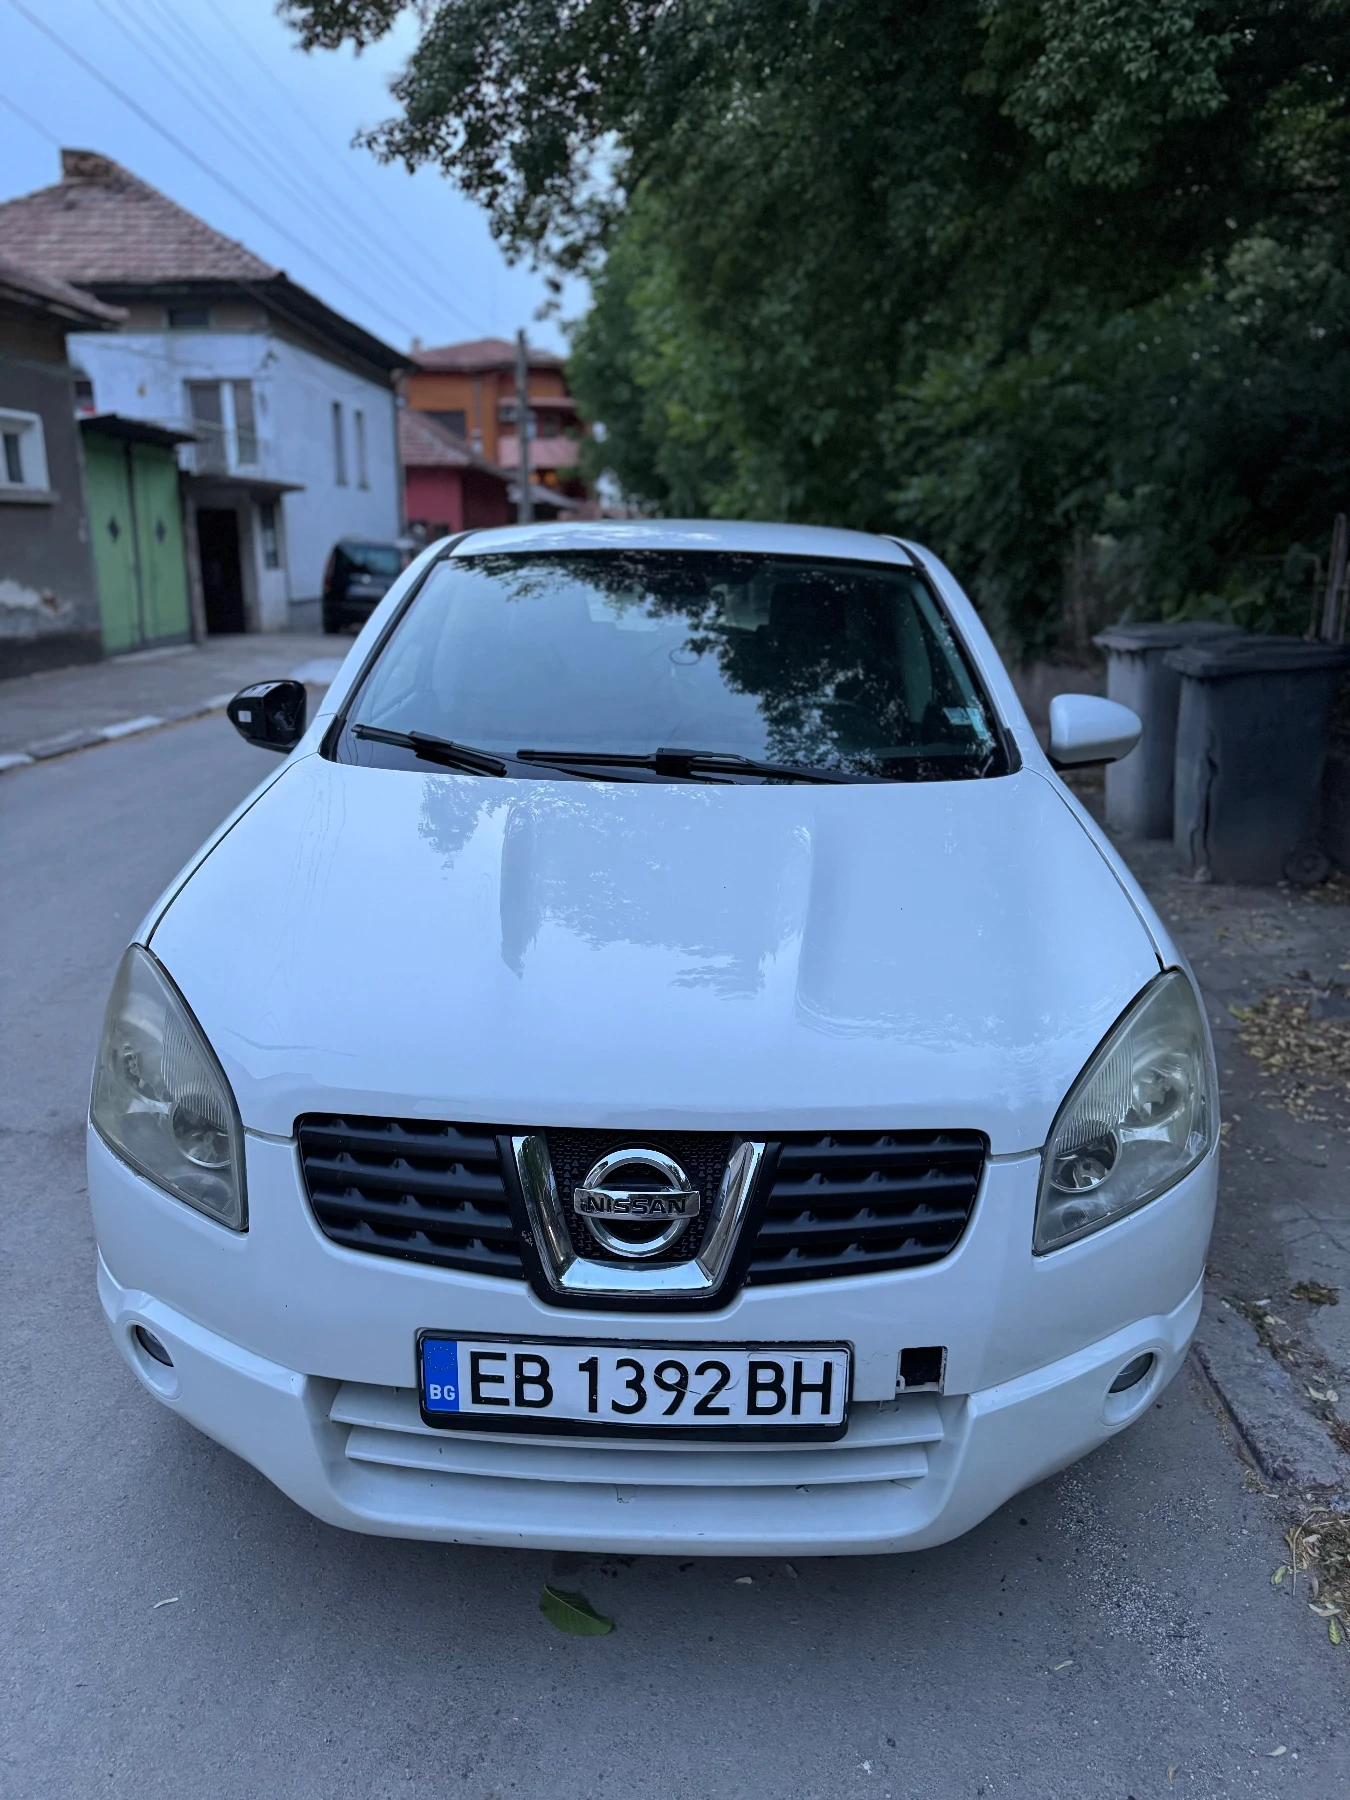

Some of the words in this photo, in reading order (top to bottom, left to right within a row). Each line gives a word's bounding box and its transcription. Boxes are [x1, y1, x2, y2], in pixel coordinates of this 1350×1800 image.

[585, 1196, 686, 1215] NISSAN
[430, 1384, 456, 1401] BG
[470, 1351, 554, 1408] EB
[578, 1357, 731, 1416] 1392
[746, 1360, 832, 1416] BH
